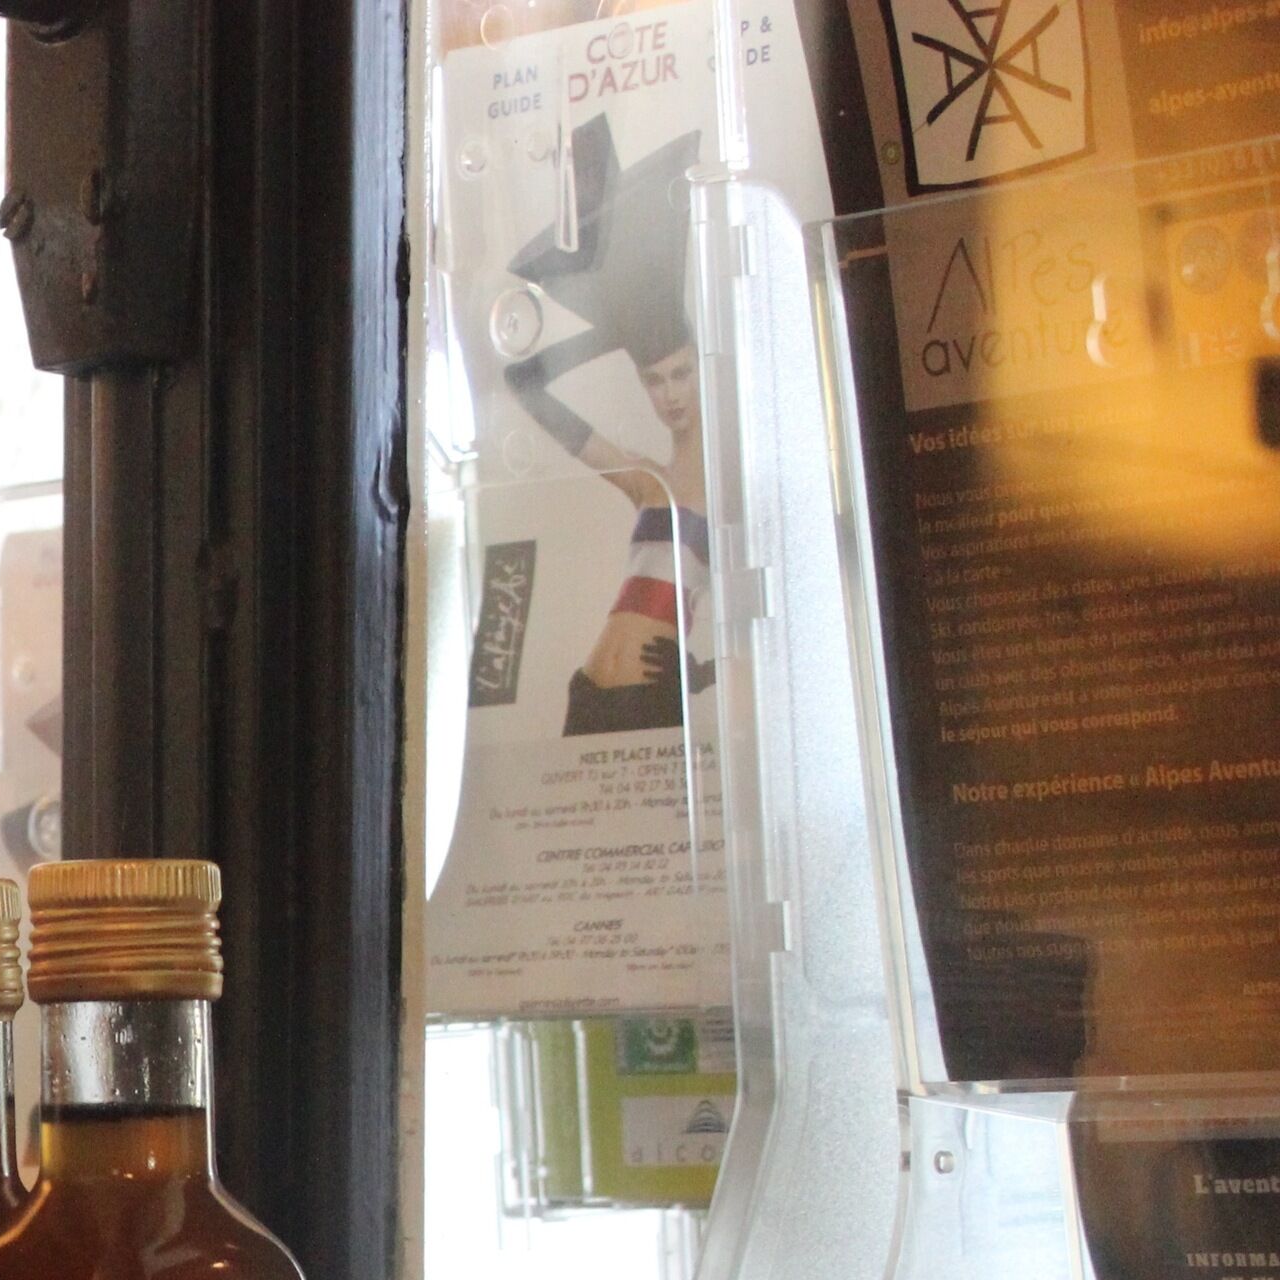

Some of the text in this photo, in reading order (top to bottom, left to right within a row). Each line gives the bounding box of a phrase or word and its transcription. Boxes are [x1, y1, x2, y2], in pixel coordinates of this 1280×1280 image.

[492, 65, 538, 90] PLAN
[568, 53, 679, 103] D'AZUR
[487, 93, 542, 118] GUIDE
[908, 432, 946, 455] Vos
[998, 508, 1037, 528] pour
[1039, 504, 1070, 523] que
[1011, 718, 1038, 738] qui
[1041, 716, 1078, 734] vous
[580, 750, 608, 765] NICE
[613, 746, 651, 763] PLACE
[953, 781, 1008, 804] Notre
[1012, 770, 1125, 803] expérience
[1145, 763, 1203, 791] Alpes
[584, 842, 666, 861] COMMERCIAL
